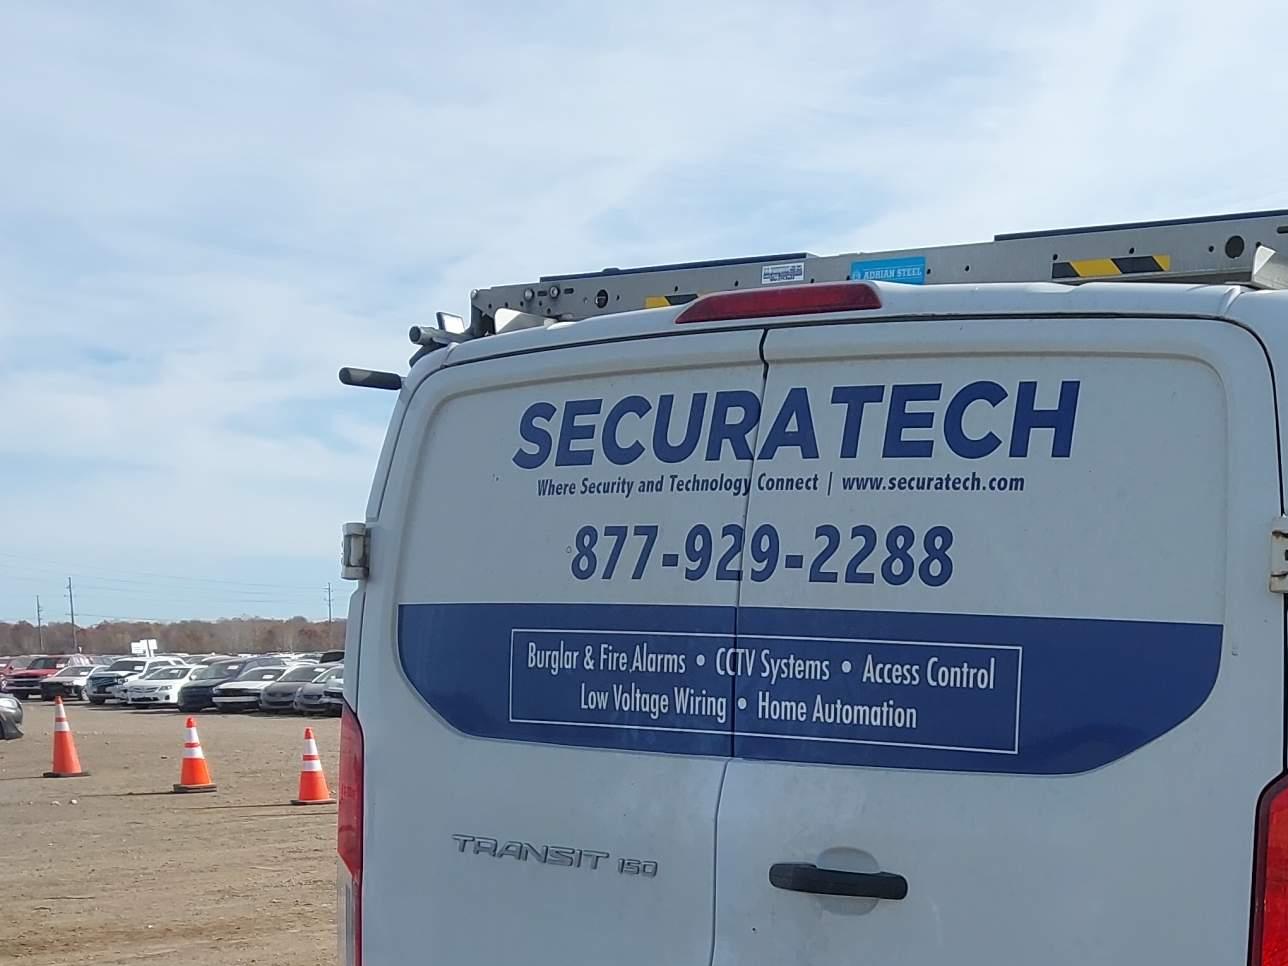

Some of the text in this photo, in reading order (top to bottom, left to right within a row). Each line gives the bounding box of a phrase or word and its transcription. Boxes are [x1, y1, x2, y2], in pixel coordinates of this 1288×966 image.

[863, 267, 923, 281] ADRIAN STEEL
[512, 381, 1080, 469] SECURATECH
[538, 471, 1025, 498] Where Security and Technology Connect www.securatech.com
[570, 523, 954, 587] 877-929-2288
[528, 640, 996, 689] Burglar & Fire Alarms CCTV Systems Access Control
[581, 682, 917, 728] Low Voltage Wiring Home Automation
[452, 834, 659, 878] TRANSIT 150
